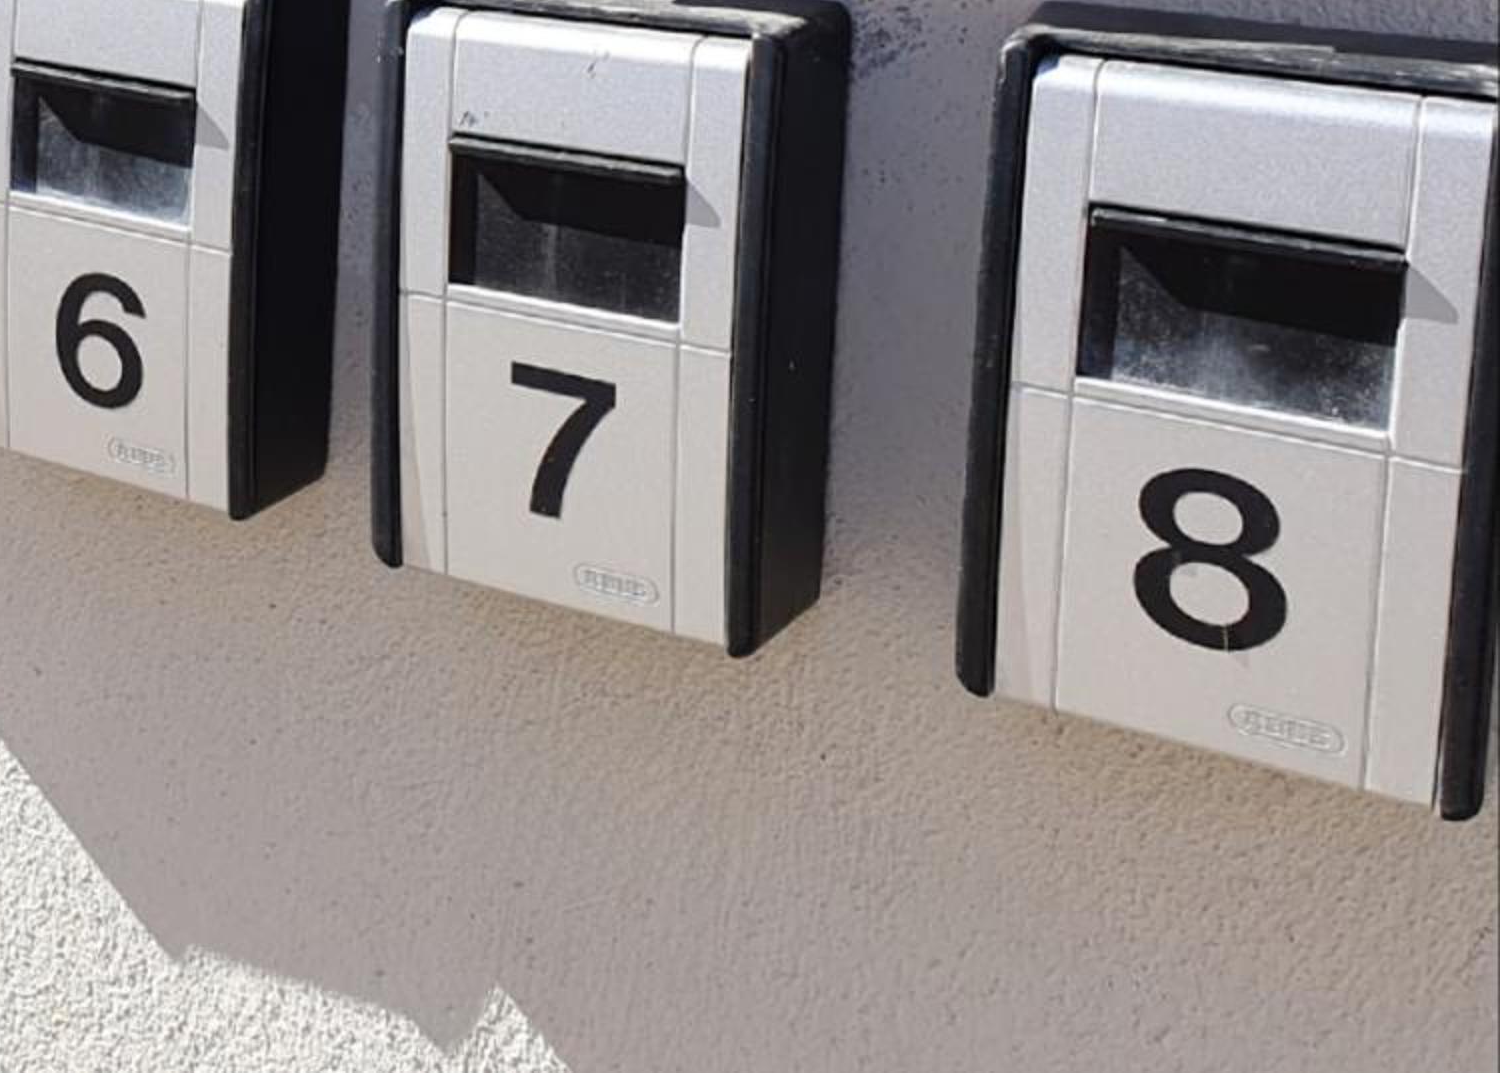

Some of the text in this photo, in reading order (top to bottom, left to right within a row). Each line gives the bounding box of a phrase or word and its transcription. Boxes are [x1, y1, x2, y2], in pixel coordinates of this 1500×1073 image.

[54, 272, 146, 410] 6
[510, 361, 617, 519] 7
[1132, 467, 1288, 653] 8
